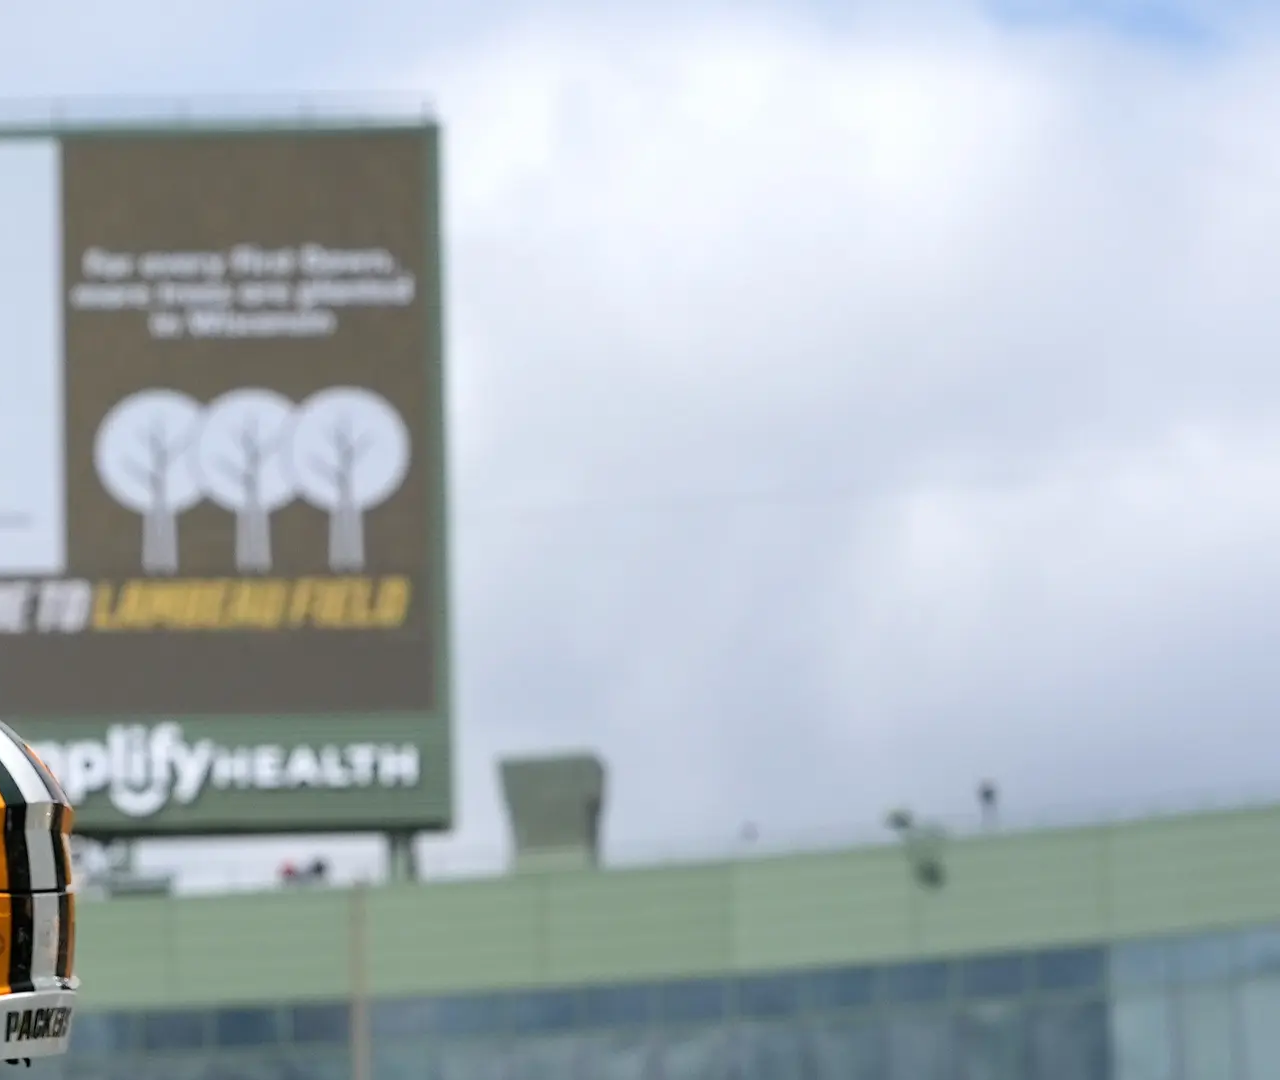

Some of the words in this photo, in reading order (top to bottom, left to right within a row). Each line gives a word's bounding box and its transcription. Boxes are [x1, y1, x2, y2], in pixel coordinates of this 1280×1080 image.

[36, 581, 90, 631] TO
[93, 579, 286, 630] LAMBEAU
[289, 577, 410, 628] FIELD
